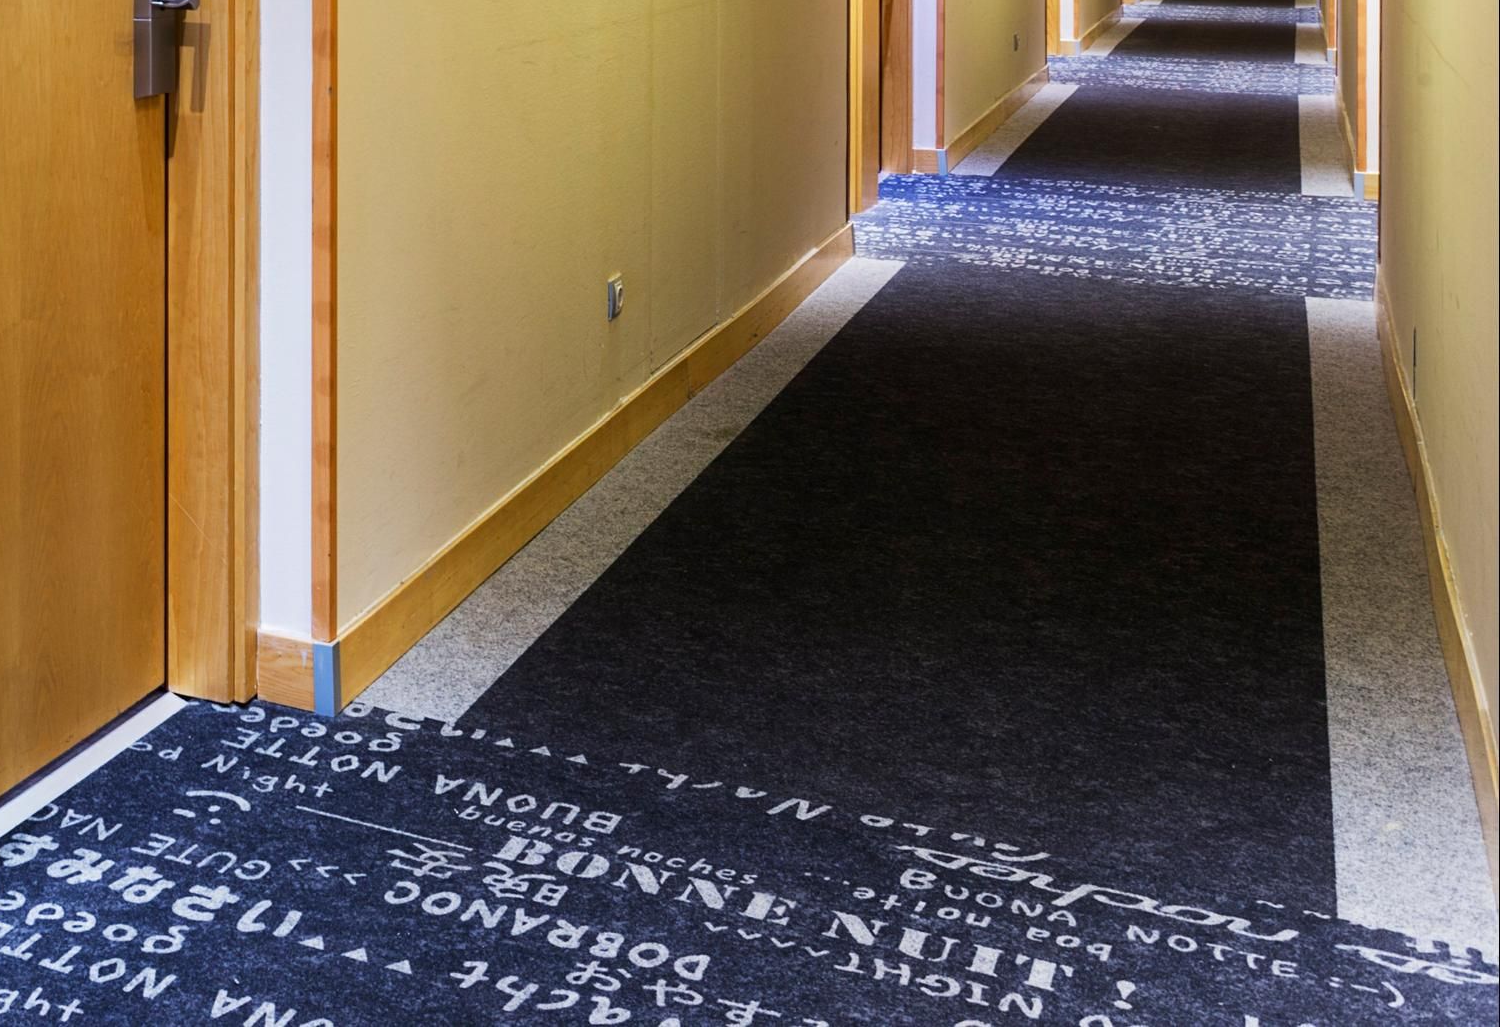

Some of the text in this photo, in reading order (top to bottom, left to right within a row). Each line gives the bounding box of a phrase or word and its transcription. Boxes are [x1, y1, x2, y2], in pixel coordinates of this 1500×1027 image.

[201, 754, 333, 798] Night
[220, 727, 623, 834] BUONA NOTTE
[130, 833, 271, 880] GUTE
[459, 805, 760, 885] buenas noches
[383, 880, 711, 981] DOBRANOC
[491, 835, 799, 921] BONNE
[821, 910, 1076, 992] NUIT
[899, 868, 1078, 928] BUONA
[1125, 924, 1302, 978] NOTTE
[1025, 926, 1113, 962] boa
[449, 960, 681, 1027] acht
[832, 952, 1043, 1020] NIGHT
